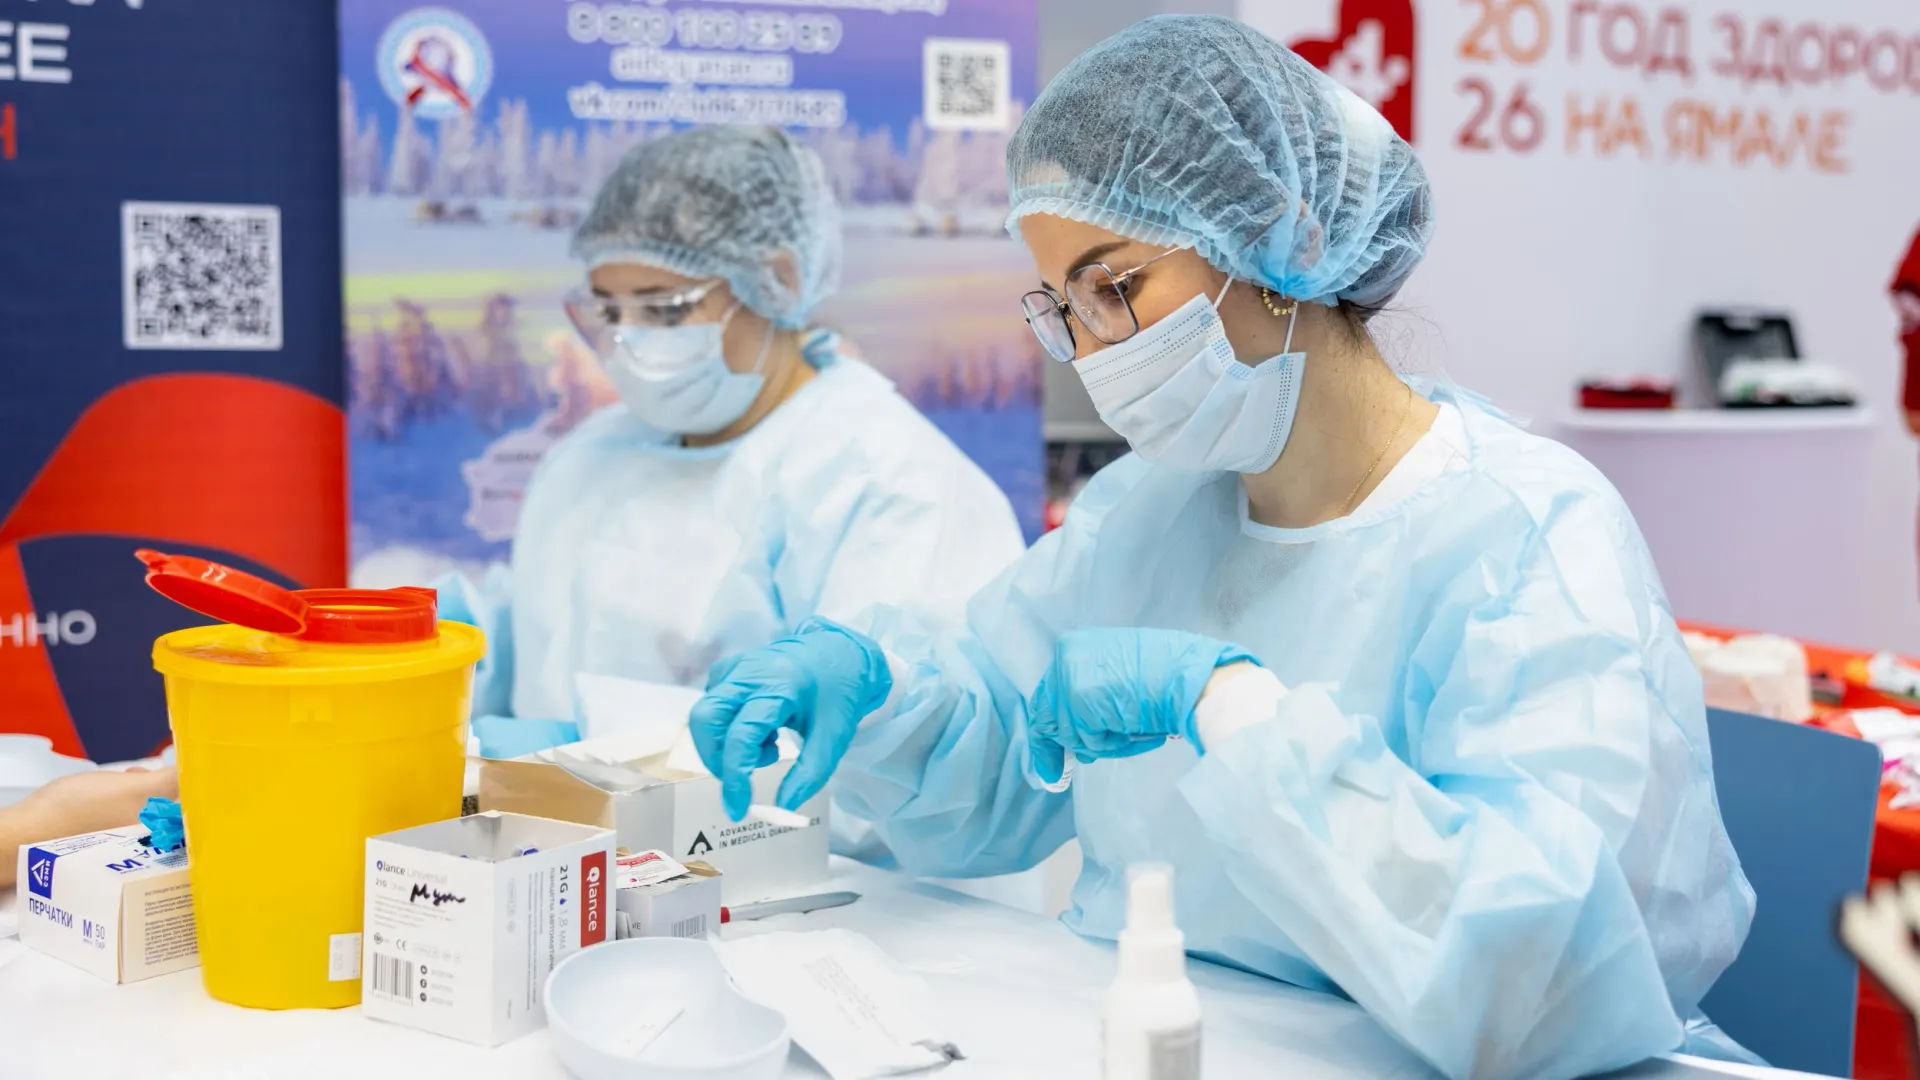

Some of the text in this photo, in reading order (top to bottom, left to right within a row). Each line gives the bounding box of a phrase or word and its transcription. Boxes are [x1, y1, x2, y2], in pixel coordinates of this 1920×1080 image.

[1457, 0, 1552, 65] 20
[1565, 0, 1696, 80] ГОД
[1455, 75, 1852, 174] 26 НА ЯМАЛЕ
[719, 821, 764, 838] ADVANCED
[719, 840, 728, 849] IN
[730, 832, 766, 846] MEDICAL
[376, 860, 406, 875] Qlance
[559, 864, 569, 894] 21G
[29, 897, 73, 929] ПЕРЧАТКИ
[586, 866, 600, 932] Qlance
